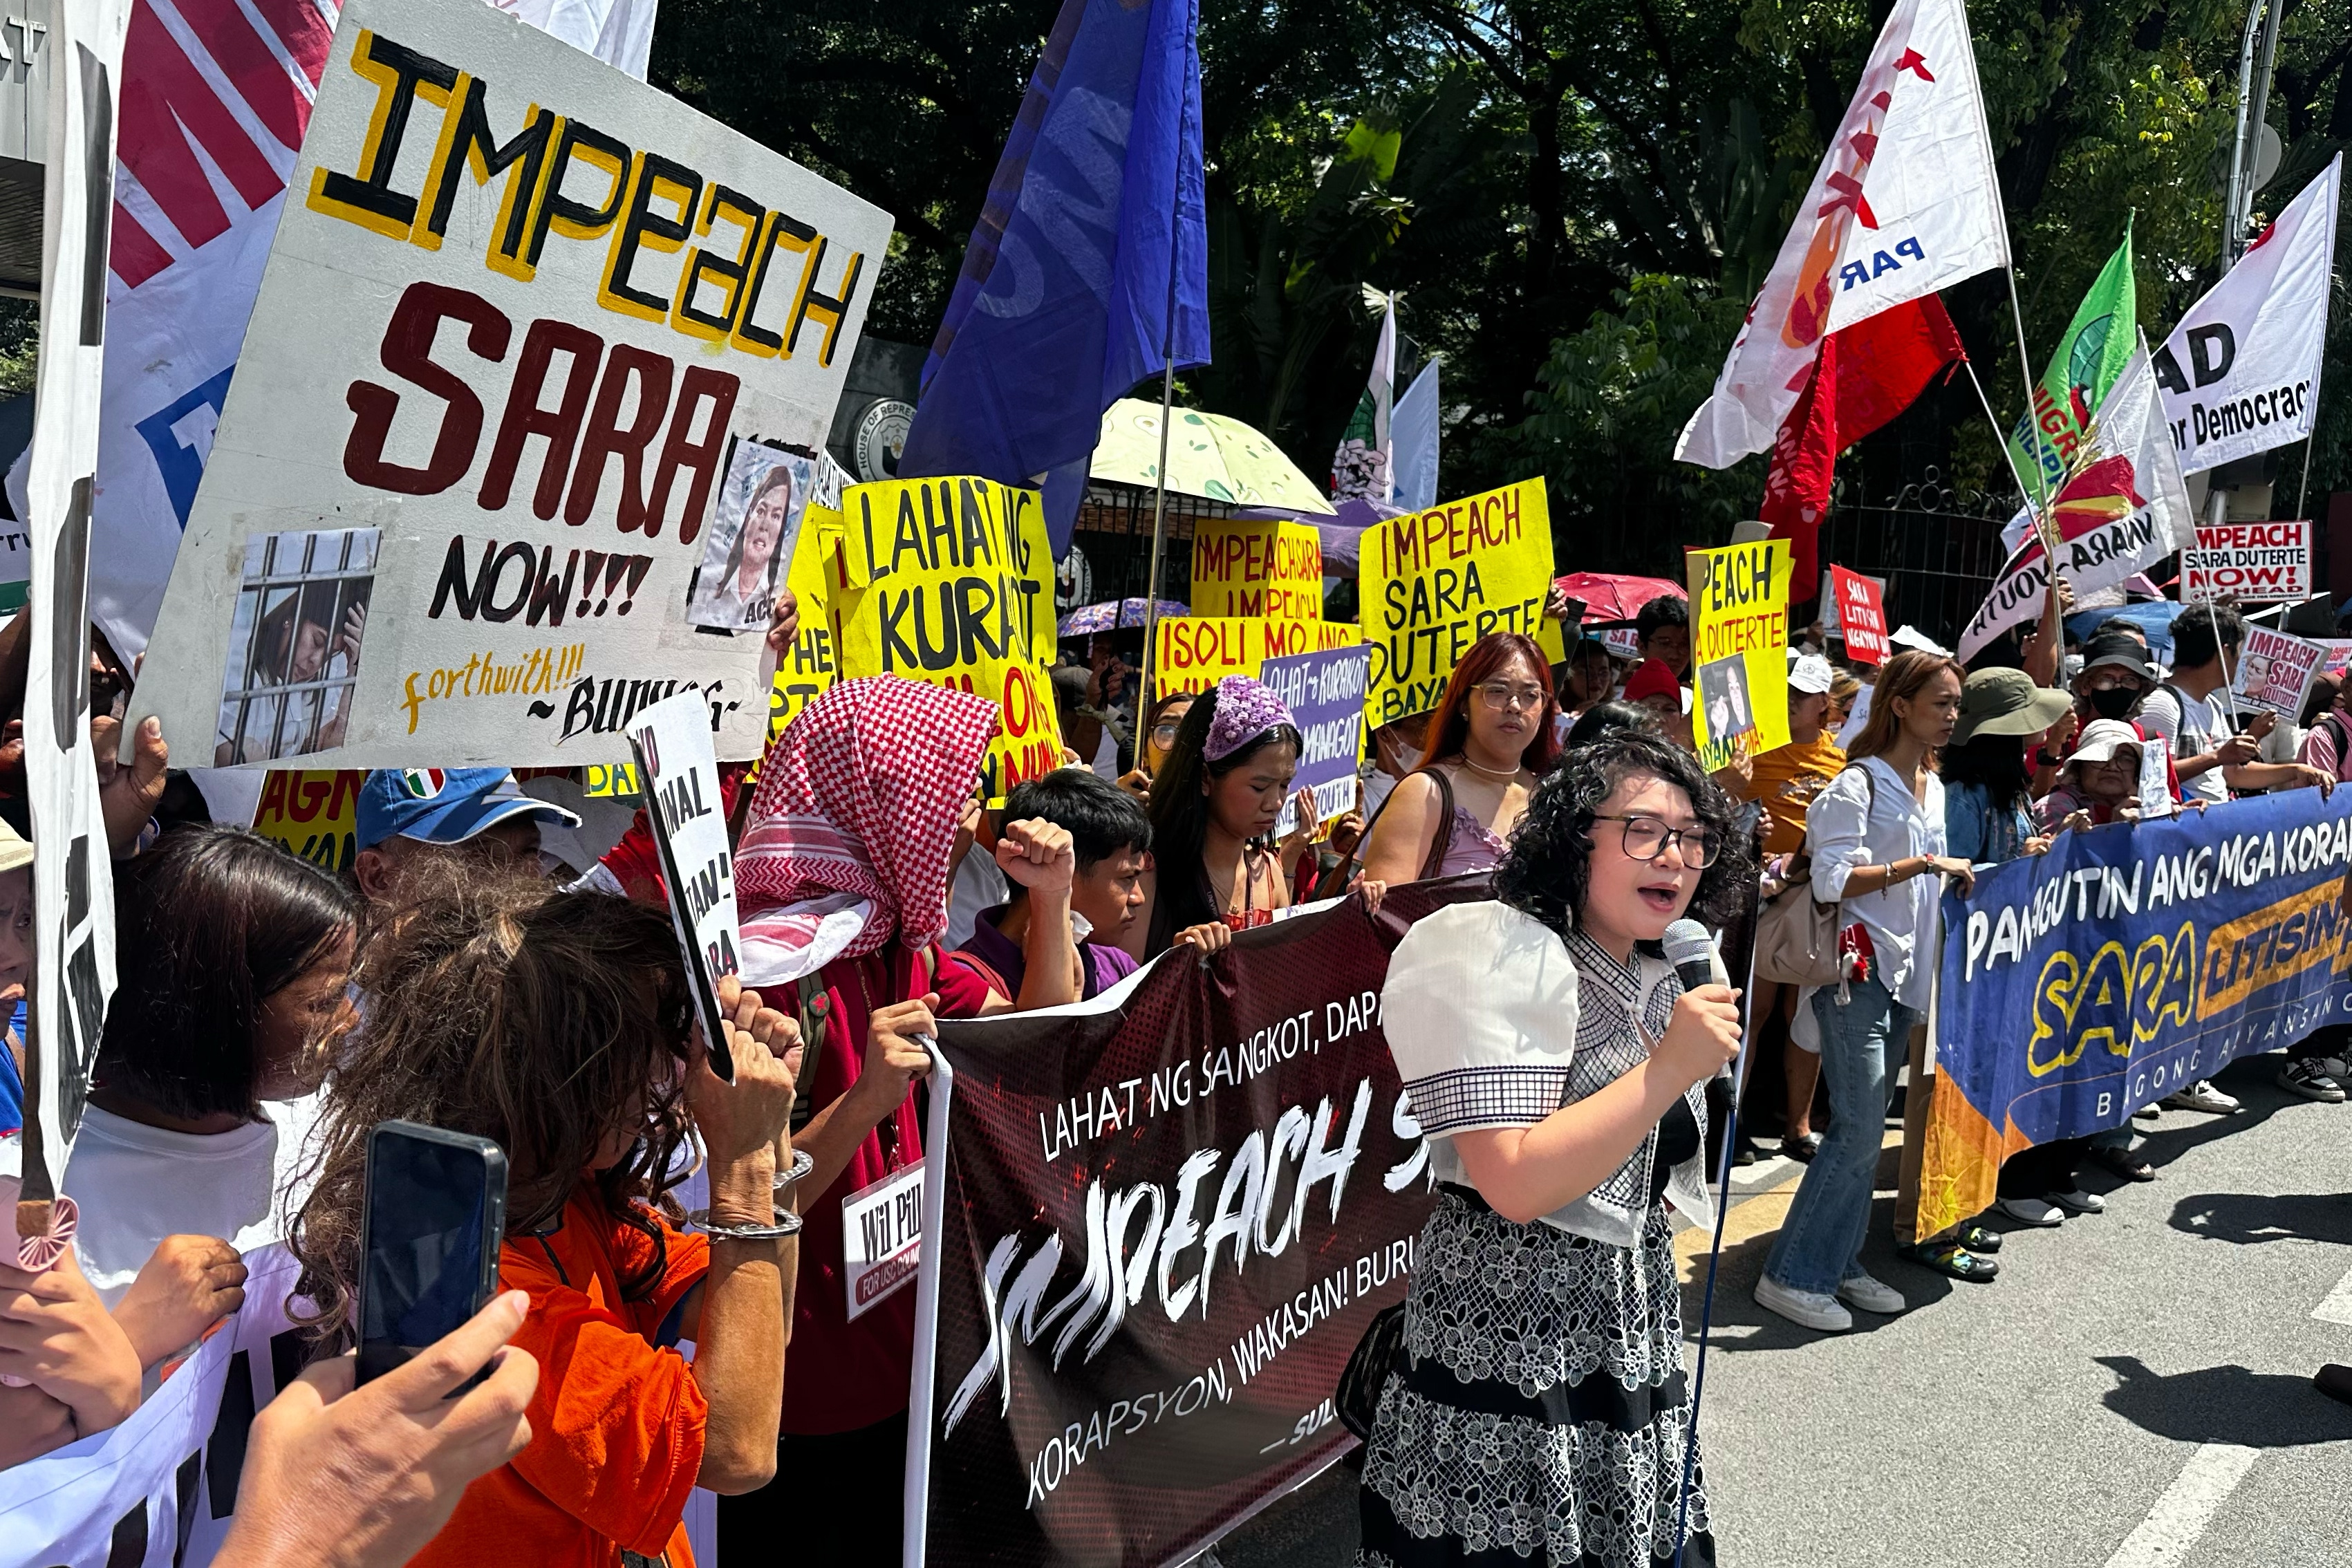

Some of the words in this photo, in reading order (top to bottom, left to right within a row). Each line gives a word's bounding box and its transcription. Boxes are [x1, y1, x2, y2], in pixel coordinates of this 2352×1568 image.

[344, 281, 740, 544] SARA
[859, 427, 870, 469] HOUSE
[868, 411, 879, 426] OF
[2192, 380, 2311, 445] Democrac
[1381, 488, 1521, 579] IMPEACH
[2185, 524, 2302, 550] MPEACH
[2185, 552, 2232, 568] SARA
[2236, 548, 2306, 566] DUTERTE
[429, 534, 653, 626] NOW!!!
[1384, 561, 1484, 631] SARA
[2189, 566, 2297, 588] NOW!
[1164, 622, 1245, 671] ISOLI
[1265, 622, 1307, 658] MO
[2248, 631, 2319, 670] IMPEACH
[2268, 662, 2306, 694] SARA
[1318, 655, 1370, 706] KURAKOT
[2147, 846, 2212, 911] ANG
[2212, 831, 2275, 894] MGA
[2281, 817, 2352, 876] KORA
[2027, 921, 2196, 1078] SARA
[1039, 1079, 1142, 1162] LAHAT
[1150, 1062, 1191, 1118] NG
[1200, 1010, 1319, 1098] SANGKOT,
[861, 1200, 892, 1266] Wil
[863, 1271, 879, 1299] FOR
[1026, 1359, 1233, 1510] KORAPSYON,
[1231, 1267, 1349, 1385] WAKASAN!
